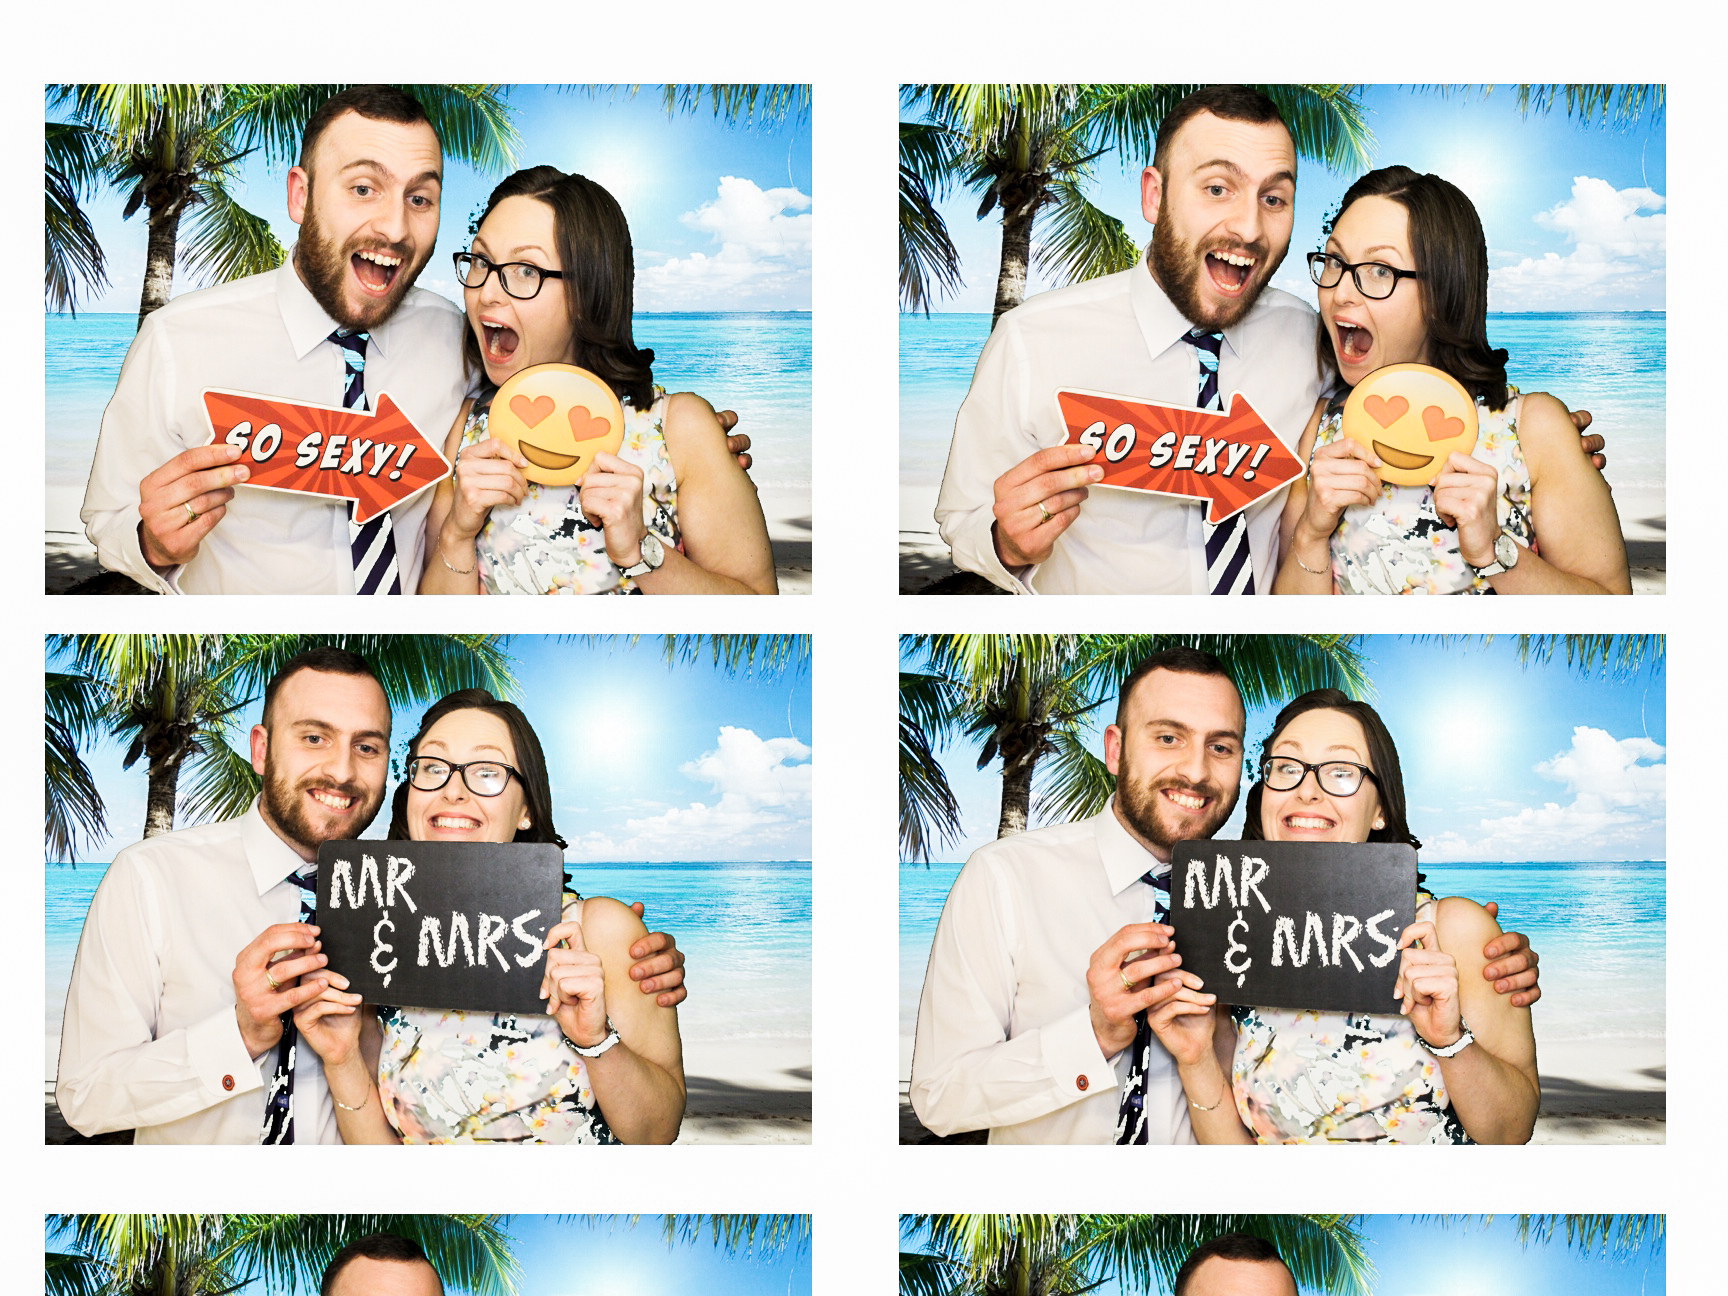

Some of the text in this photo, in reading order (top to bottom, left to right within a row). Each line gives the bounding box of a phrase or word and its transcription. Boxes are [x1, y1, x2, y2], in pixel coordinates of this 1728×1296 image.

[225, 420, 417, 482] SO SEXY!
[1079, 420, 1271, 482] SO SEXY!
[329, 854, 418, 914] MR
[1183, 854, 1272, 914] MR
[369, 908, 545, 989] & MRS
[1223, 908, 1399, 989] & MRS
